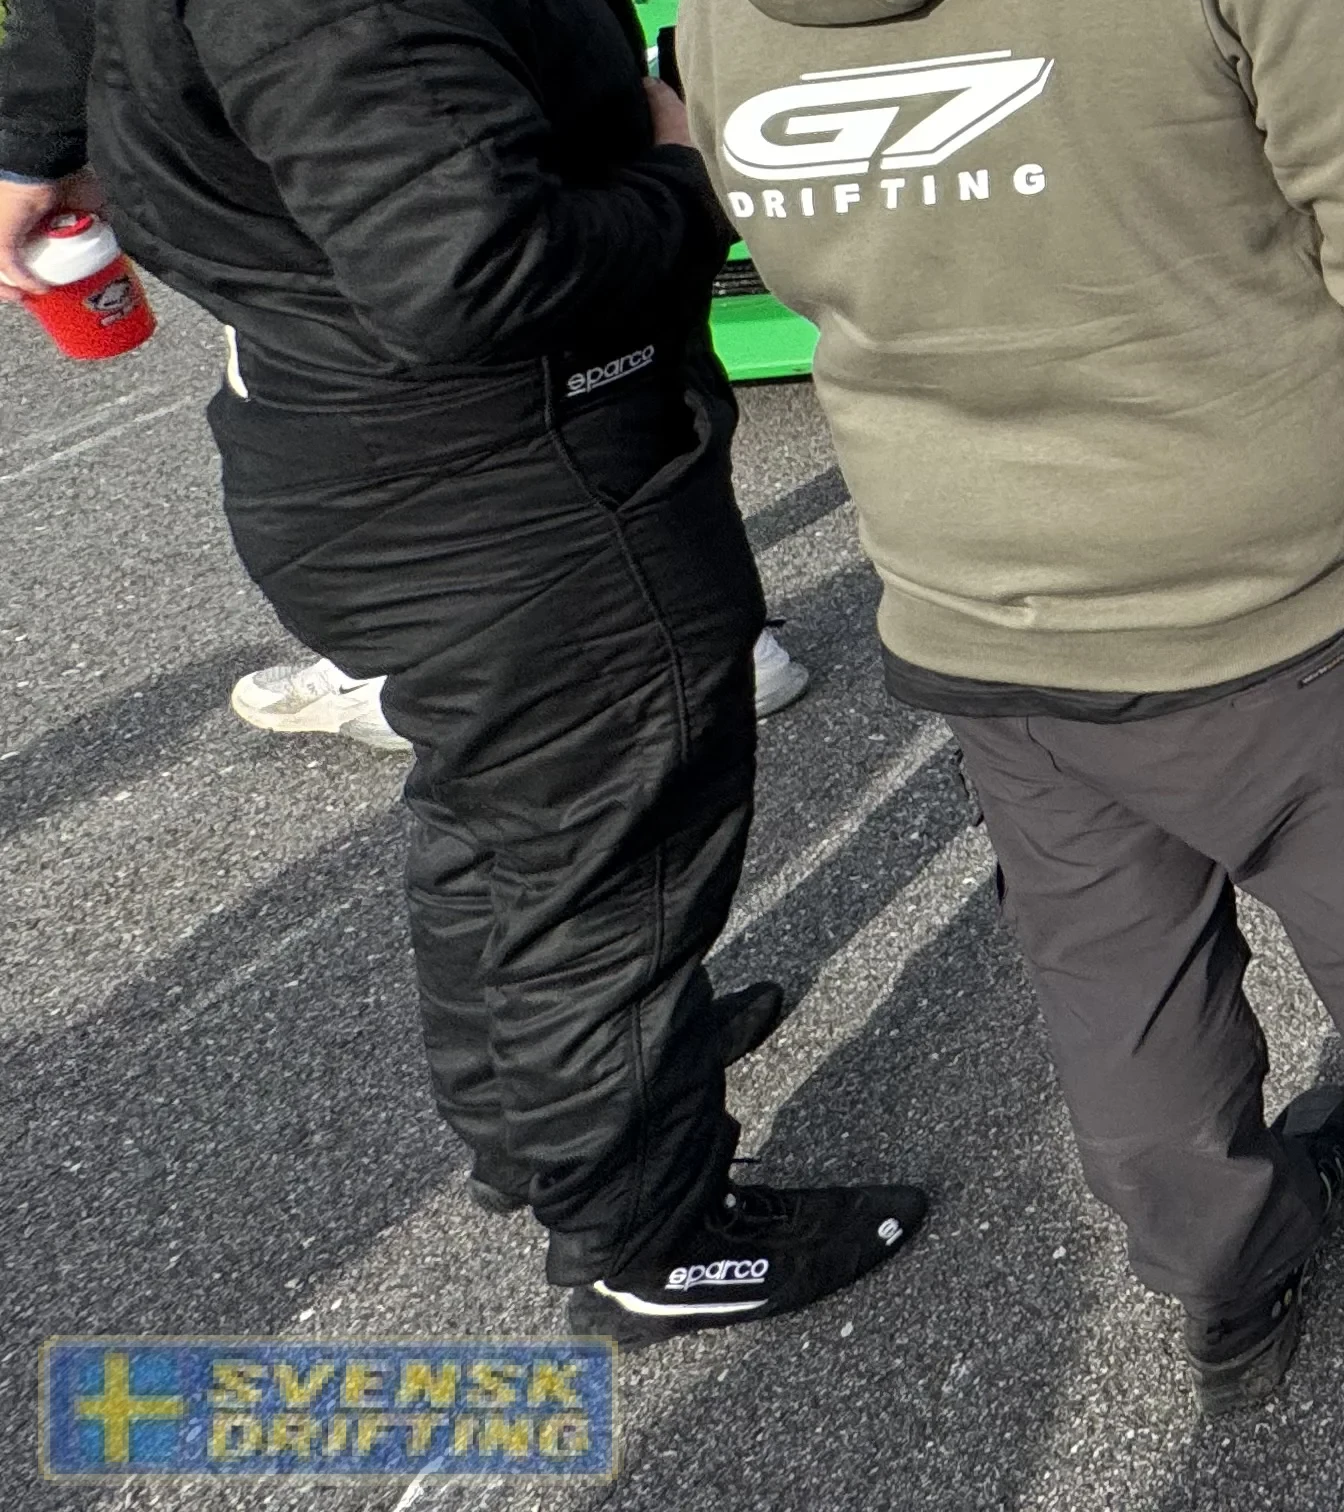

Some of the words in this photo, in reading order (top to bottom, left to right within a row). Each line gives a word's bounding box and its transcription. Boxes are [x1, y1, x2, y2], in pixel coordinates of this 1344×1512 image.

[723, 49, 1054, 180] G7
[728, 163, 1046, 218] DRIFTING
[566, 345, 655, 397] sparco
[666, 1258, 769, 1290] sparco
